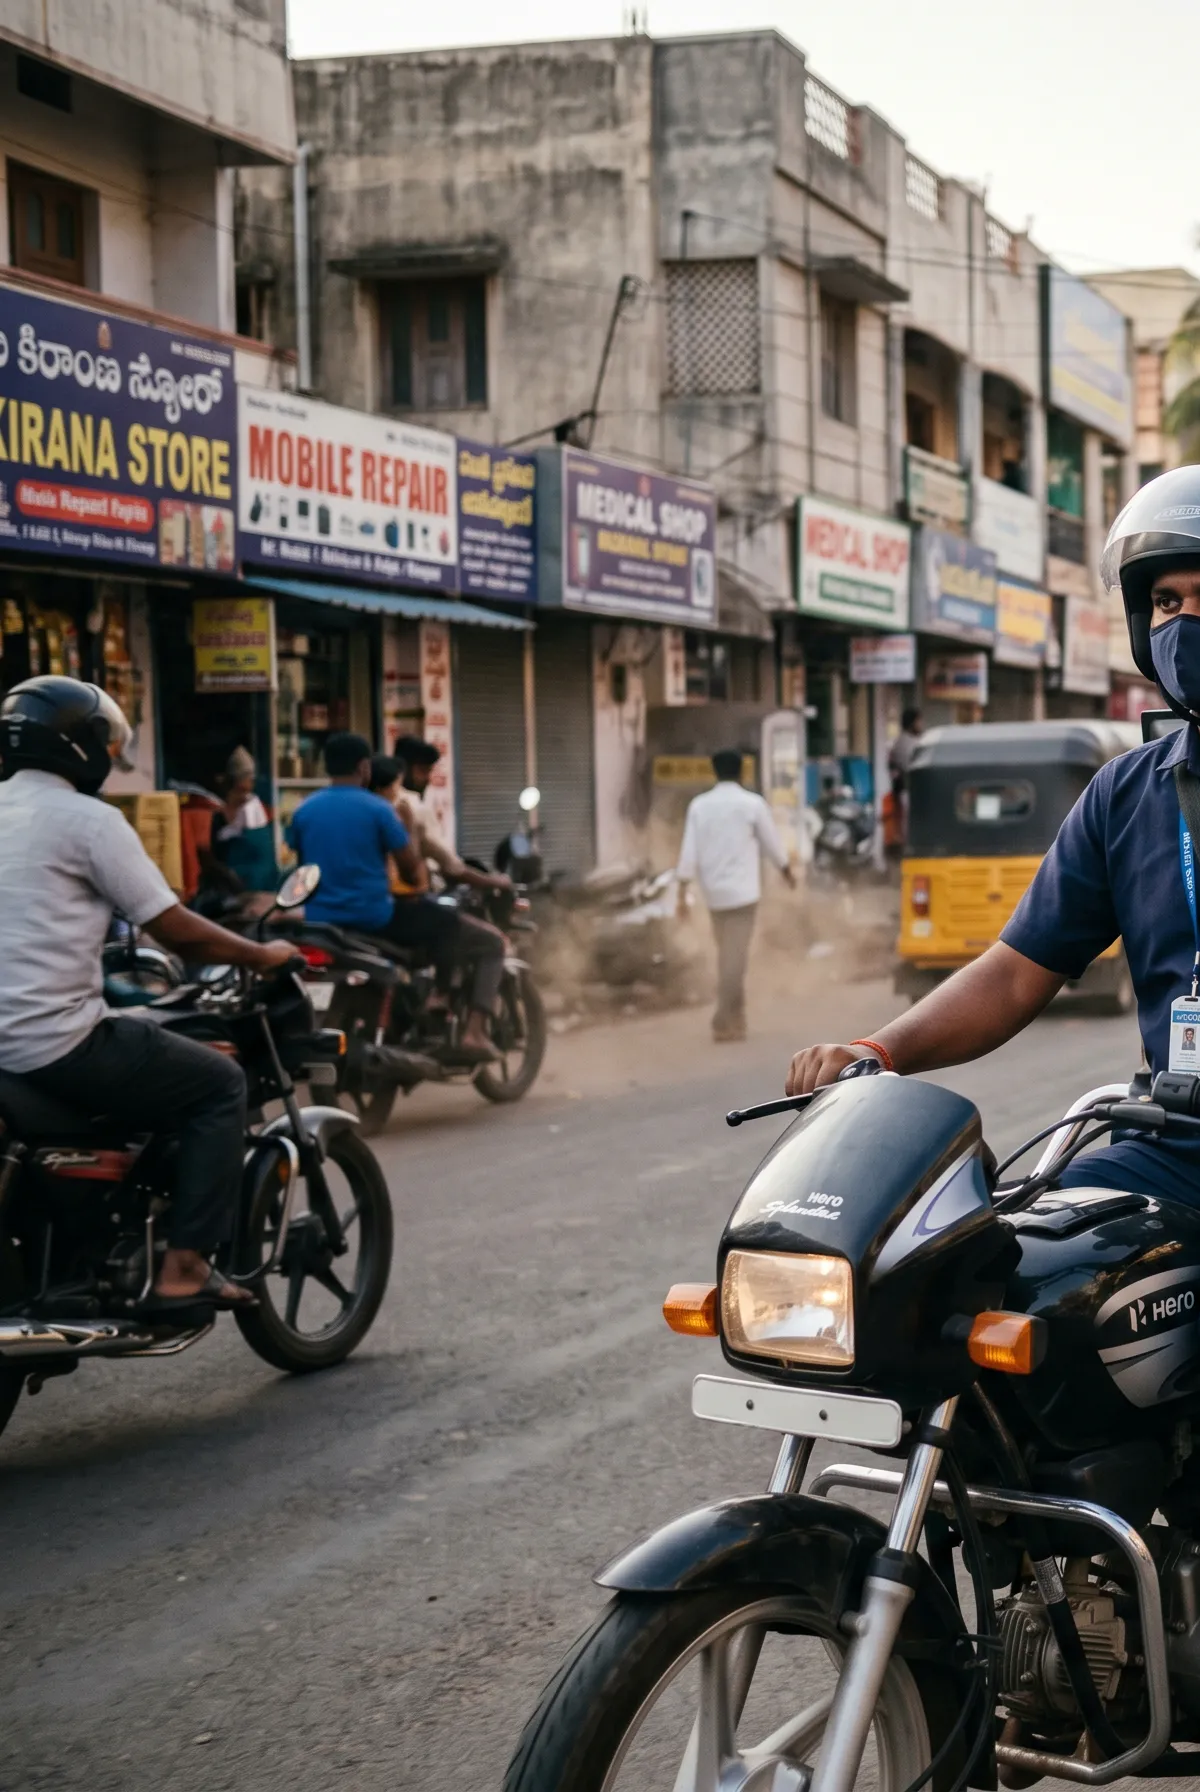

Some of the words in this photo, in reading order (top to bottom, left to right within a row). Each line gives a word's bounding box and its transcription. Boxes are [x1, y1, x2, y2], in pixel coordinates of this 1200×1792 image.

[127, 423, 232, 500] STORE
[248, 423, 354, 498] MOBILE
[360, 450, 449, 517] REPAIR
[576, 481, 658, 536] MEDICAL
[658, 501, 708, 545] SHOP
[806, 1191, 844, 1208] Hero
[1152, 1290, 1195, 1321] Hero
